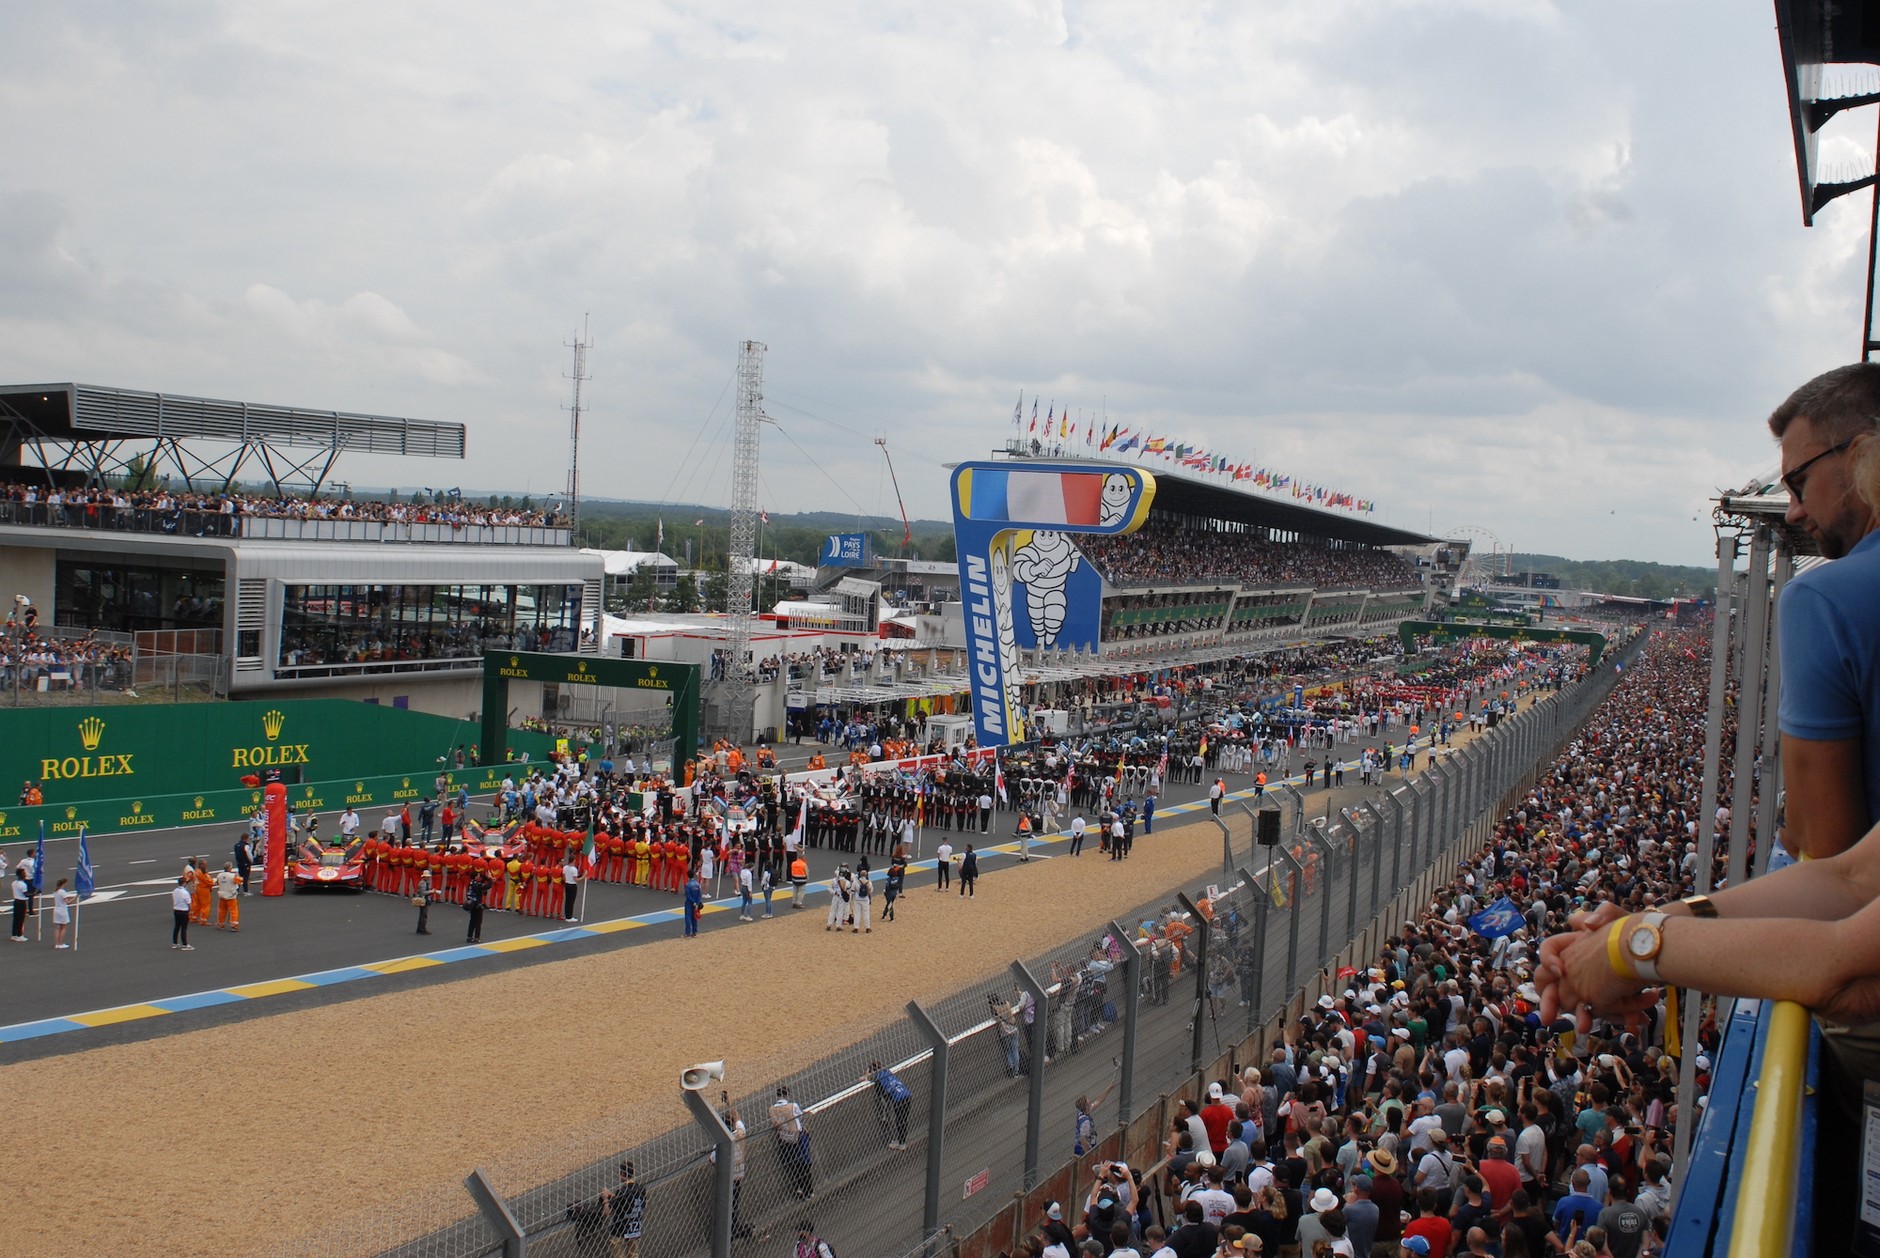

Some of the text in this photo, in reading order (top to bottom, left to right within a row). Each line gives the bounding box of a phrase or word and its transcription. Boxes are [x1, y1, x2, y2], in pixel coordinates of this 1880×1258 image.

[843, 540, 861, 549] PAYS
[841, 551, 861, 559] LOIRE
[966, 554, 1003, 735] MICHELIN
[500, 667, 528, 678] ROLEX
[567, 673, 597, 683] ROLEX
[637, 678, 668, 688] ROLEX
[232, 744, 310, 768] ROLEX
[41, 754, 134, 780] ROLEX
[447, 784, 462, 793] LEX
[480, 780, 502, 790] ROLEX
[346, 793, 373, 804] ROLEX
[394, 788, 419, 799] ROLEX
[295, 798, 324, 809] ROLEX
[182, 808, 215, 820] ROLEX
[120, 814, 155, 826] ROLEX
[52, 820, 90, 832] ROLEX
